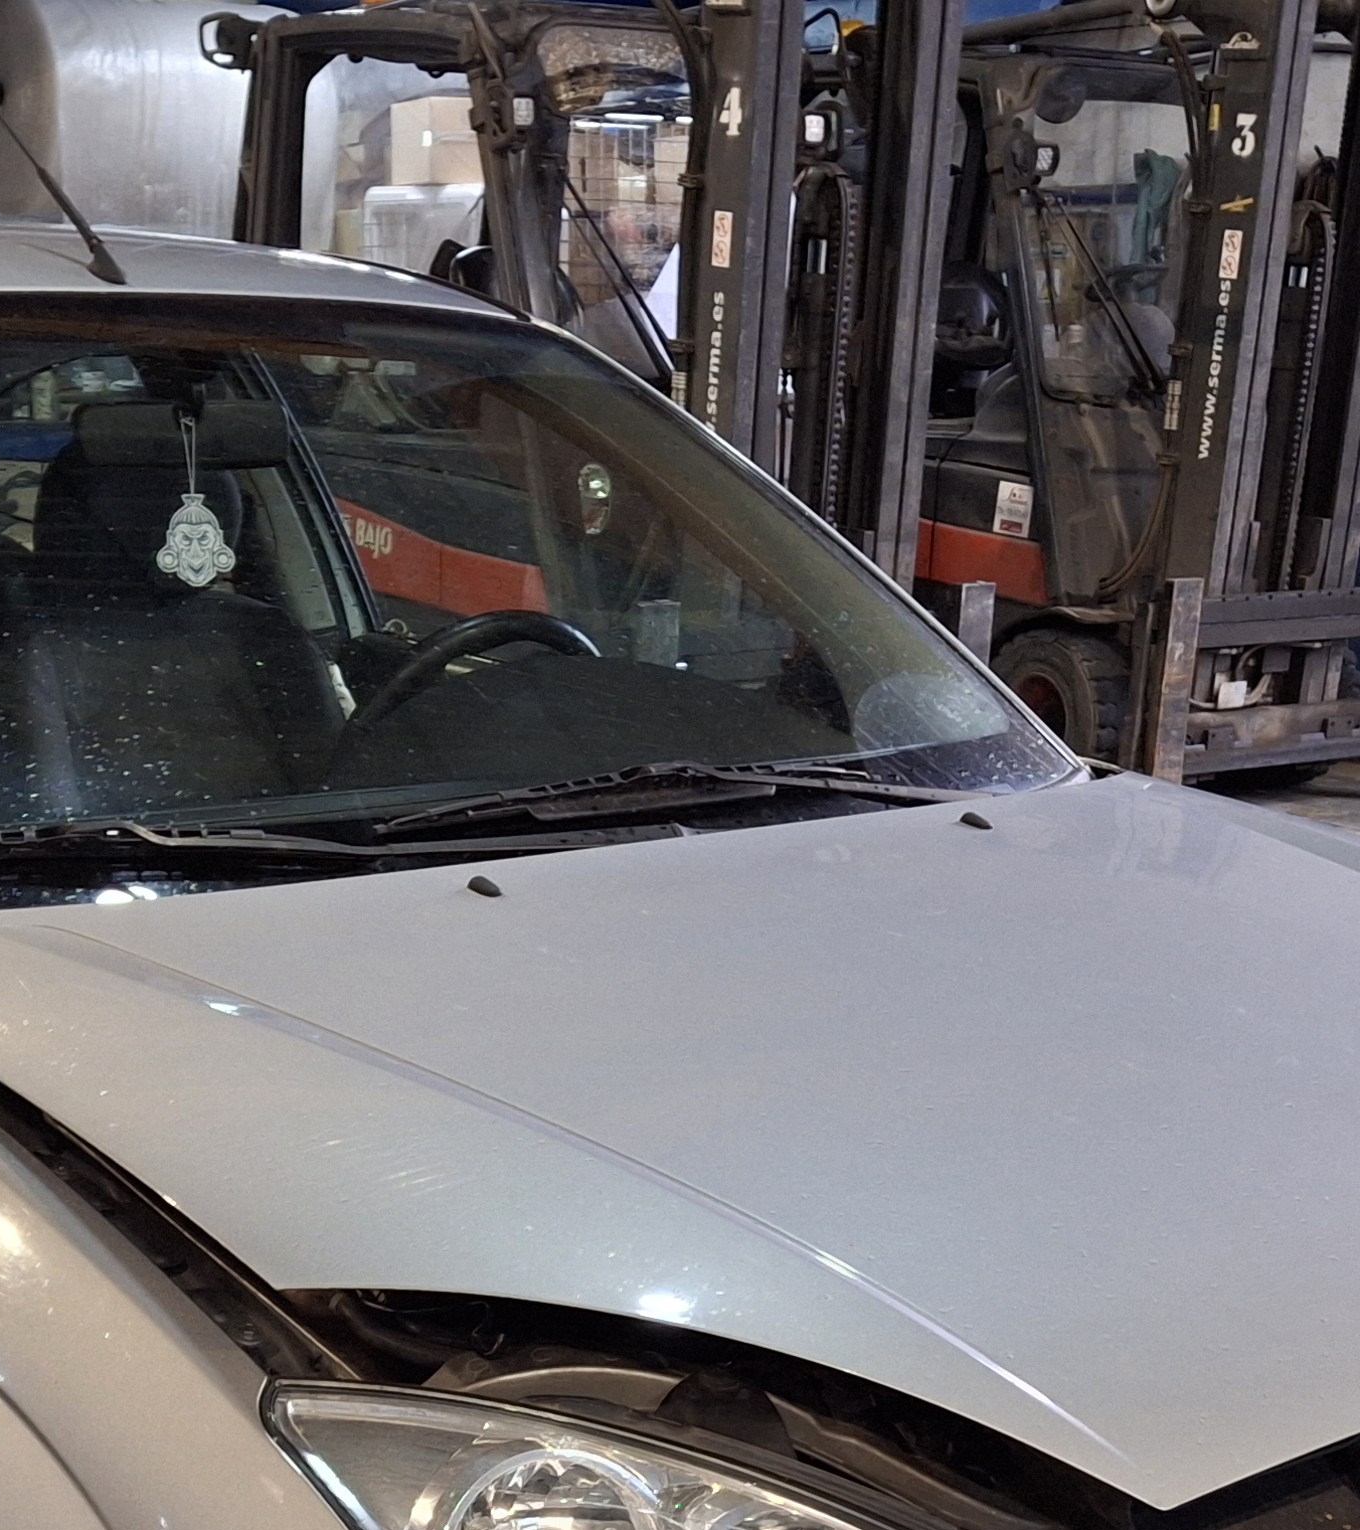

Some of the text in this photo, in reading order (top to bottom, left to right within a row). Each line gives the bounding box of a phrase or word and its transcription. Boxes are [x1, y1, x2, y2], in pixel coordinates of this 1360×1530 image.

[719, 87, 743, 136] 4
[1231, 112, 1258, 157] 3
[705, 291, 725, 432] .serma.es
[1197, 279, 1232, 460] www.serma.es
